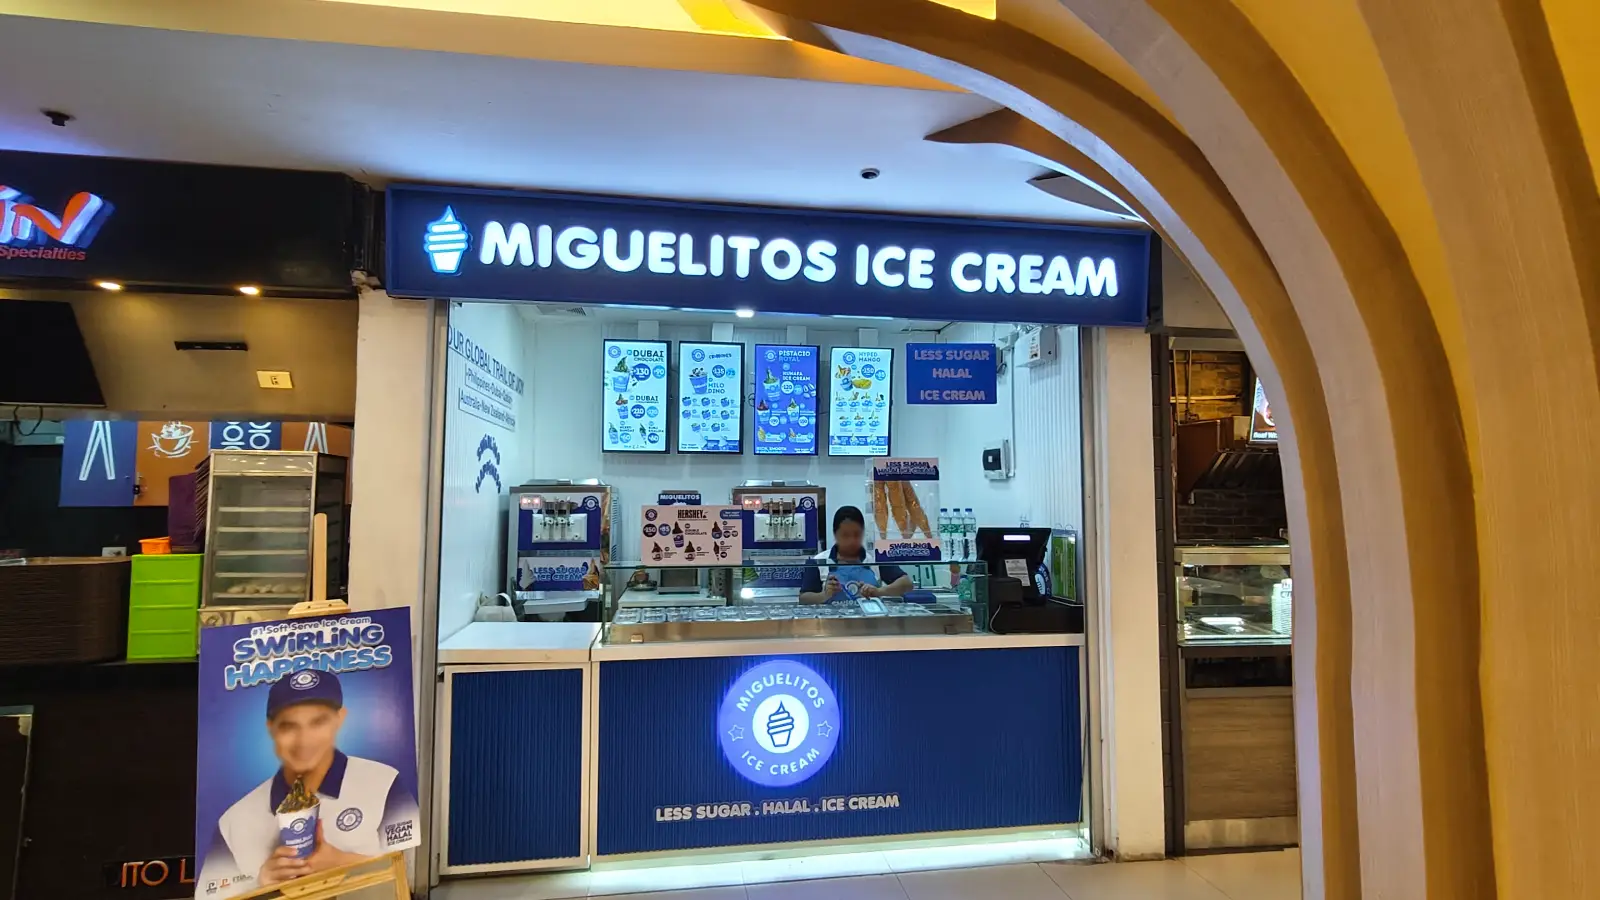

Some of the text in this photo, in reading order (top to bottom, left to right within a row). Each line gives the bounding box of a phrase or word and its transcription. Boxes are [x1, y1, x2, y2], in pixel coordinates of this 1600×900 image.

[479, 220, 1119, 297] MIGUELITOS ICE CREAM
[633, 349, 664, 358] DUBAI
[914, 350, 990, 361] LESS SUGAR
[465, 337, 492, 375] GLOBAL
[493, 358, 508, 386] TRAIL
[932, 368, 972, 379] HALAL
[920, 390, 986, 401] ICE CREAM
[533, 567, 586, 575] LESS SUGAR
[537, 573, 583, 581] ICE CREAM
[251, 616, 371, 636] #1 Soft Serve Ice Cream
[736, 672, 825, 712] MIGUELITOS
[741, 747, 820, 775] ICE CREAM
[656, 807, 692, 821] LESS
[696, 804, 750, 819] SUGAR
[763, 800, 811, 815] HALAL
[822, 798, 844, 812] ICE
[848, 795, 900, 810] CREAM
[385, 824, 413, 836] VEGAN
[387, 830, 412, 841] HALAL
